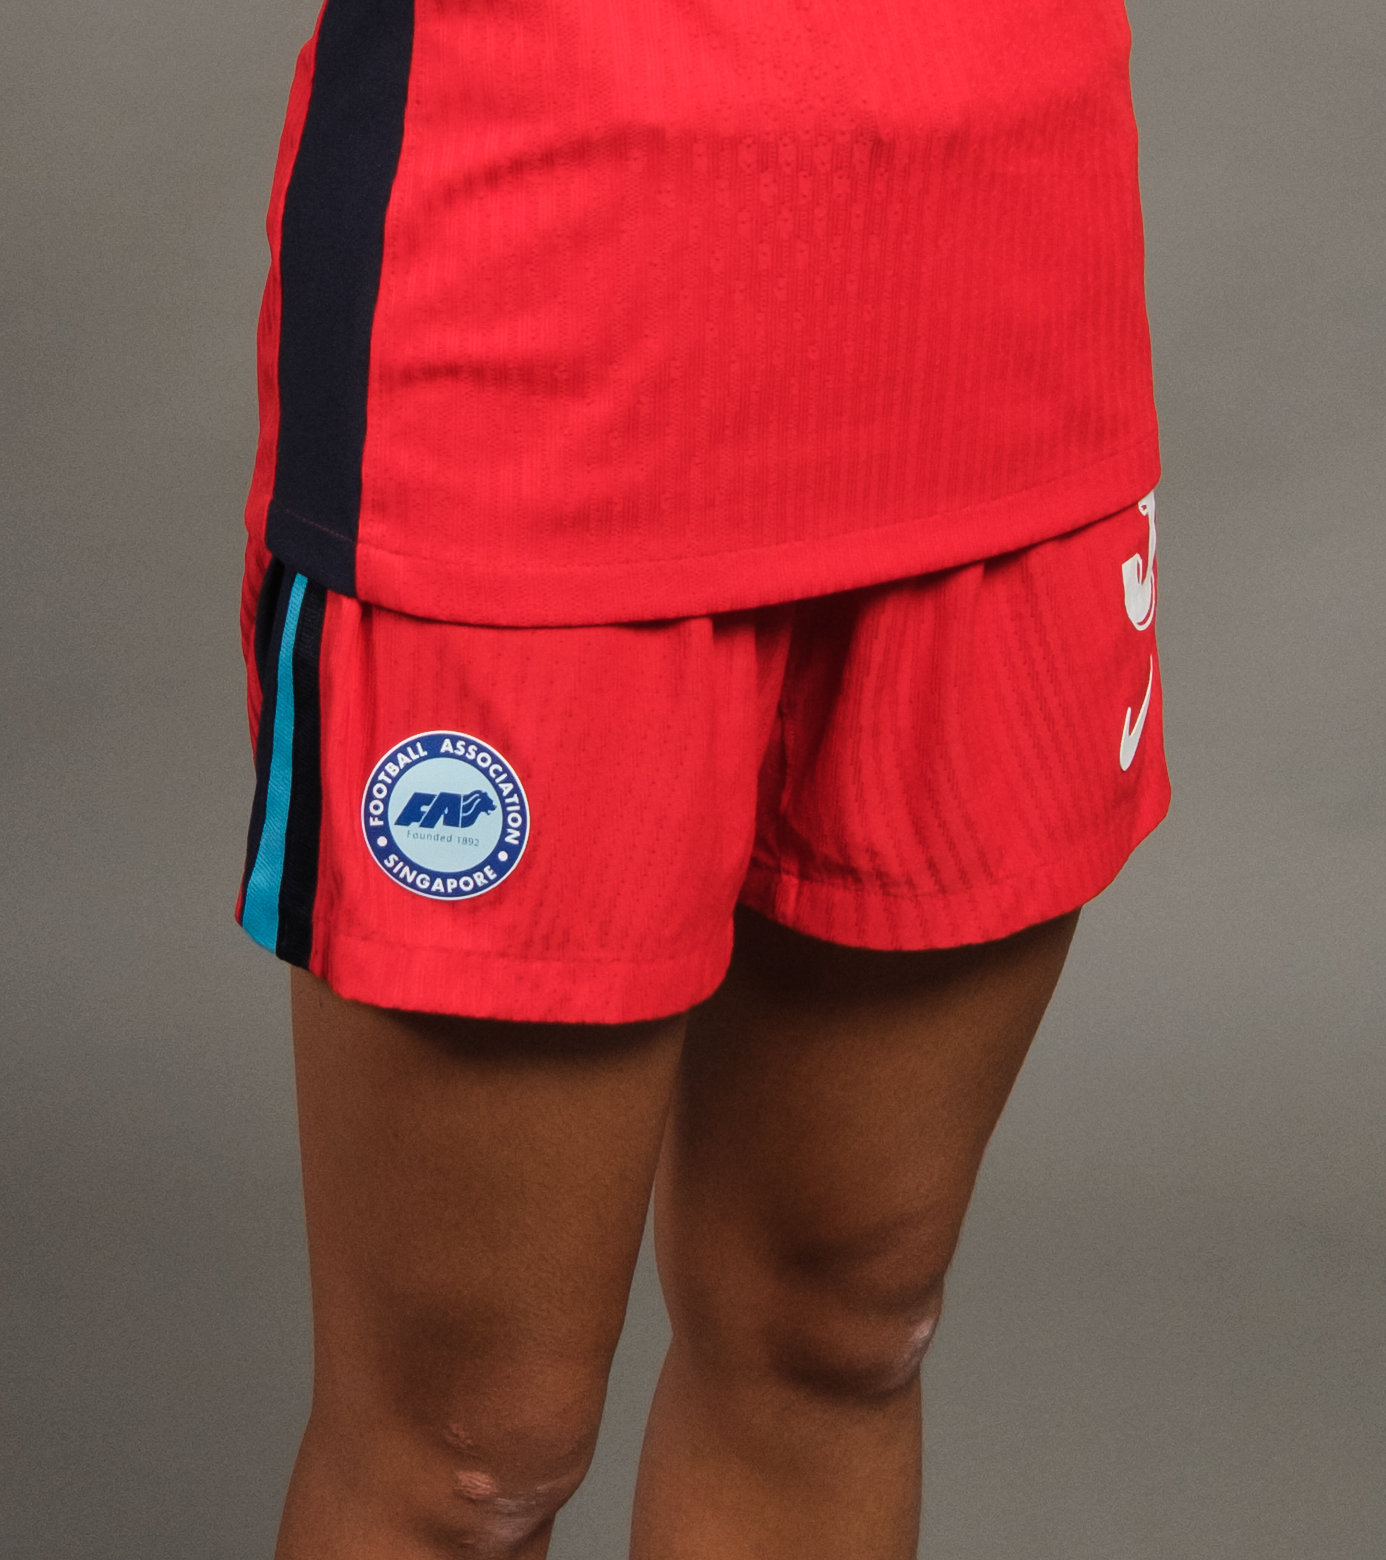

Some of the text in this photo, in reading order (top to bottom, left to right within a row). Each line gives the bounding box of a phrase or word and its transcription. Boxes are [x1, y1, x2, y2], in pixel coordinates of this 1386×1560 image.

[369, 738, 523, 845] FOOTBALL ASSOCIATION
[406, 829, 480, 847] Founded 1892
[383, 853, 498, 893] SINGAPORE
